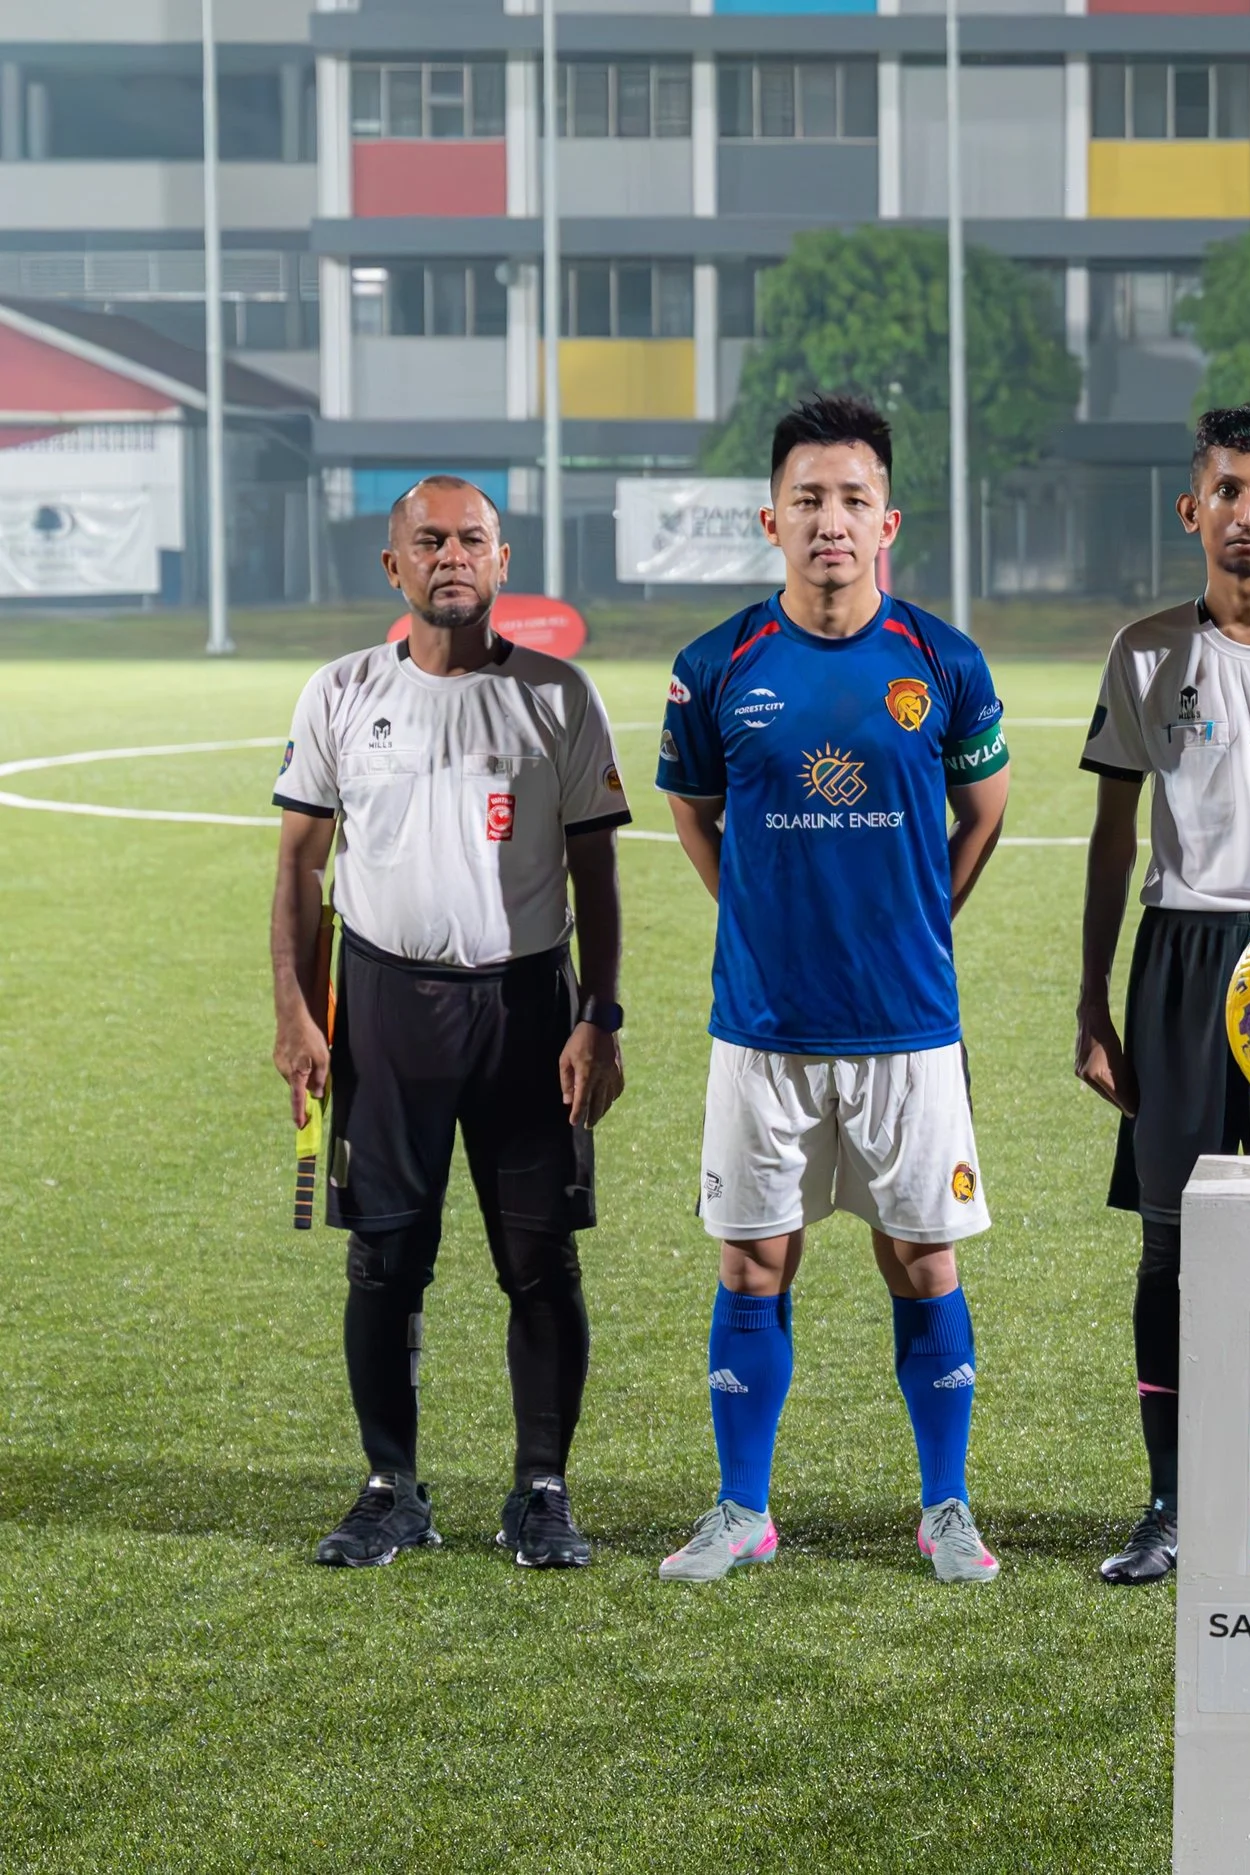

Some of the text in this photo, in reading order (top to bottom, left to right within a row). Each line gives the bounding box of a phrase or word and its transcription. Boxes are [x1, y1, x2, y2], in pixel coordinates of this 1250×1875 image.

[734, 702, 785, 715] FOREST CITY
[368, 741, 393, 749] MILLS
[765, 811, 905, 829] SOLARLINK ENERGY
